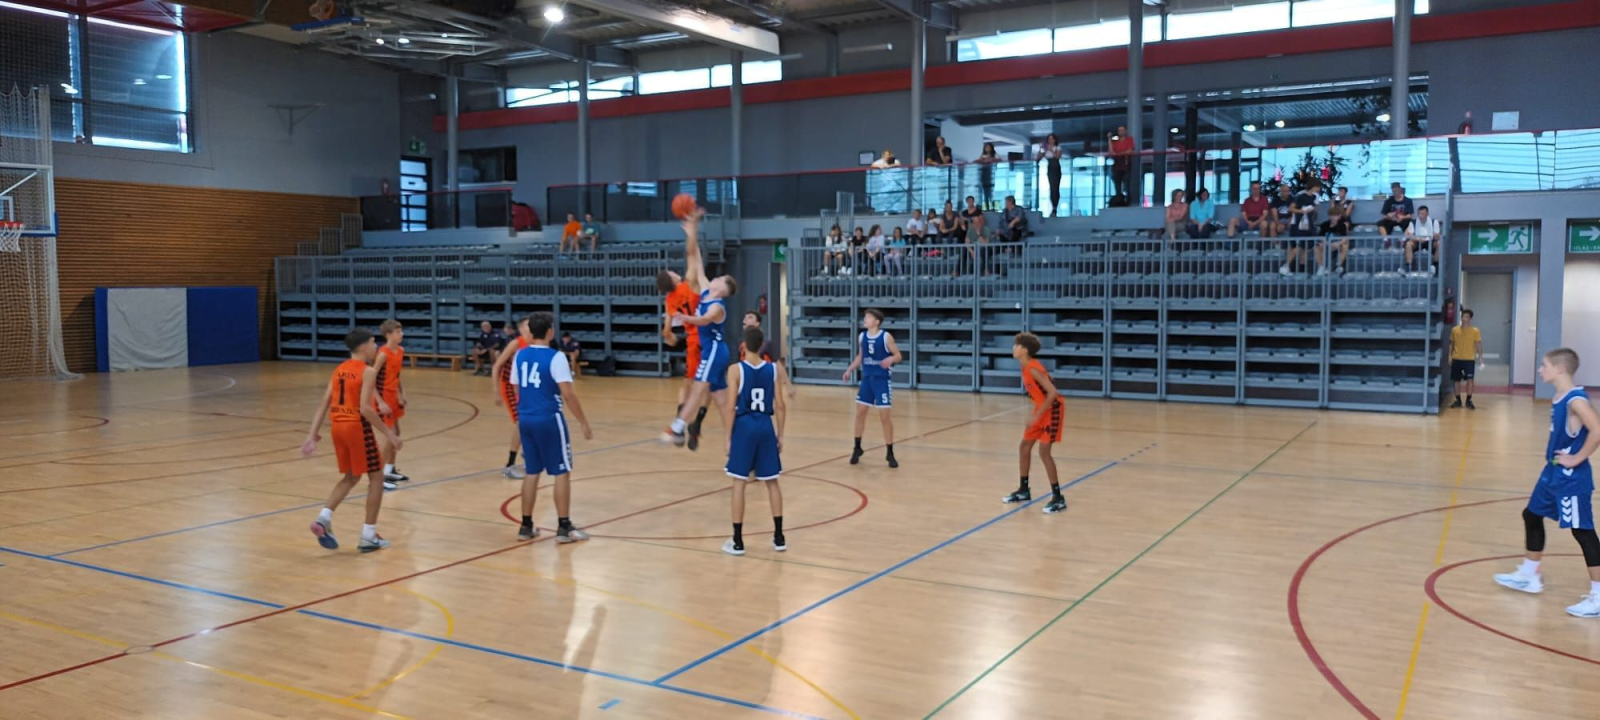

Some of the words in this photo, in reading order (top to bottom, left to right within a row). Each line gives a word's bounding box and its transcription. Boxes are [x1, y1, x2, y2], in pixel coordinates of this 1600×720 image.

[868, 343, 875, 354] 5
[521, 361, 541, 388] 14
[338, 378, 345, 405] 1
[750, 387, 765, 412] 8
[881, 393, 888, 403] 5
